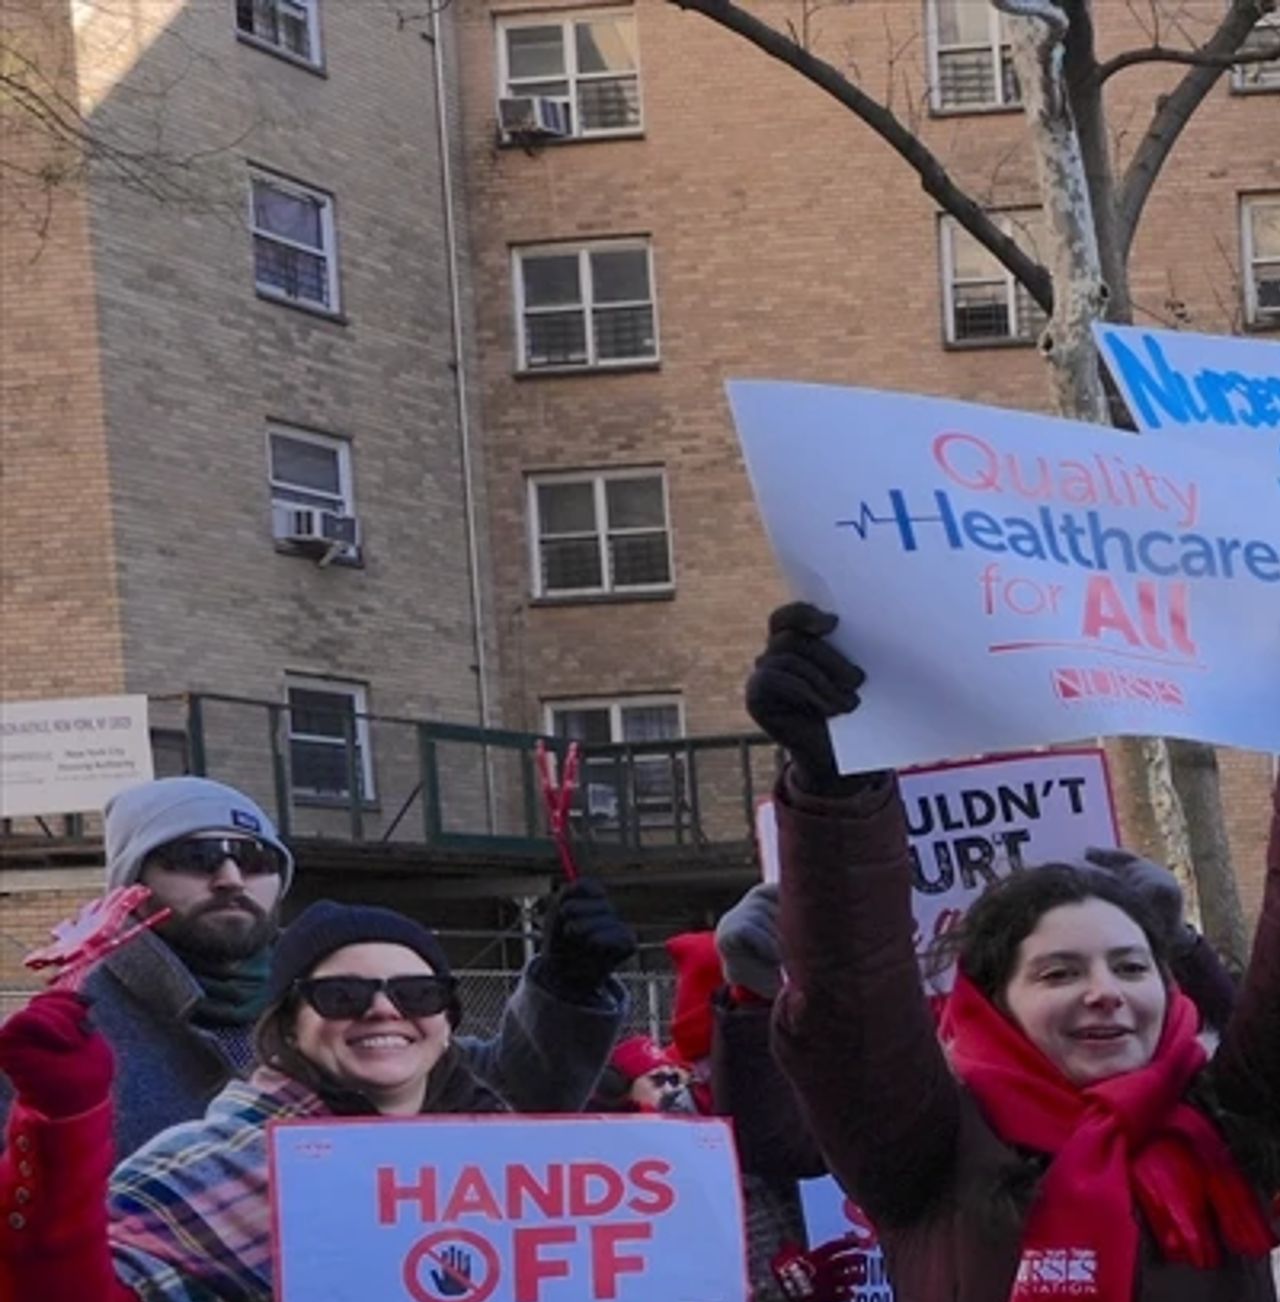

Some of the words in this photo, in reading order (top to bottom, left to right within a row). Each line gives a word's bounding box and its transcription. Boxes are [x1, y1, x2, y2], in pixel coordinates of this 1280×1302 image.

[932, 432, 1199, 526] Quality
[978, 562, 1062, 615] for
[1080, 575, 1197, 655] All
[904, 776, 1086, 836] ULDN'T
[911, 828, 1030, 895] URT
[376, 1159, 676, 1225] HANDS
